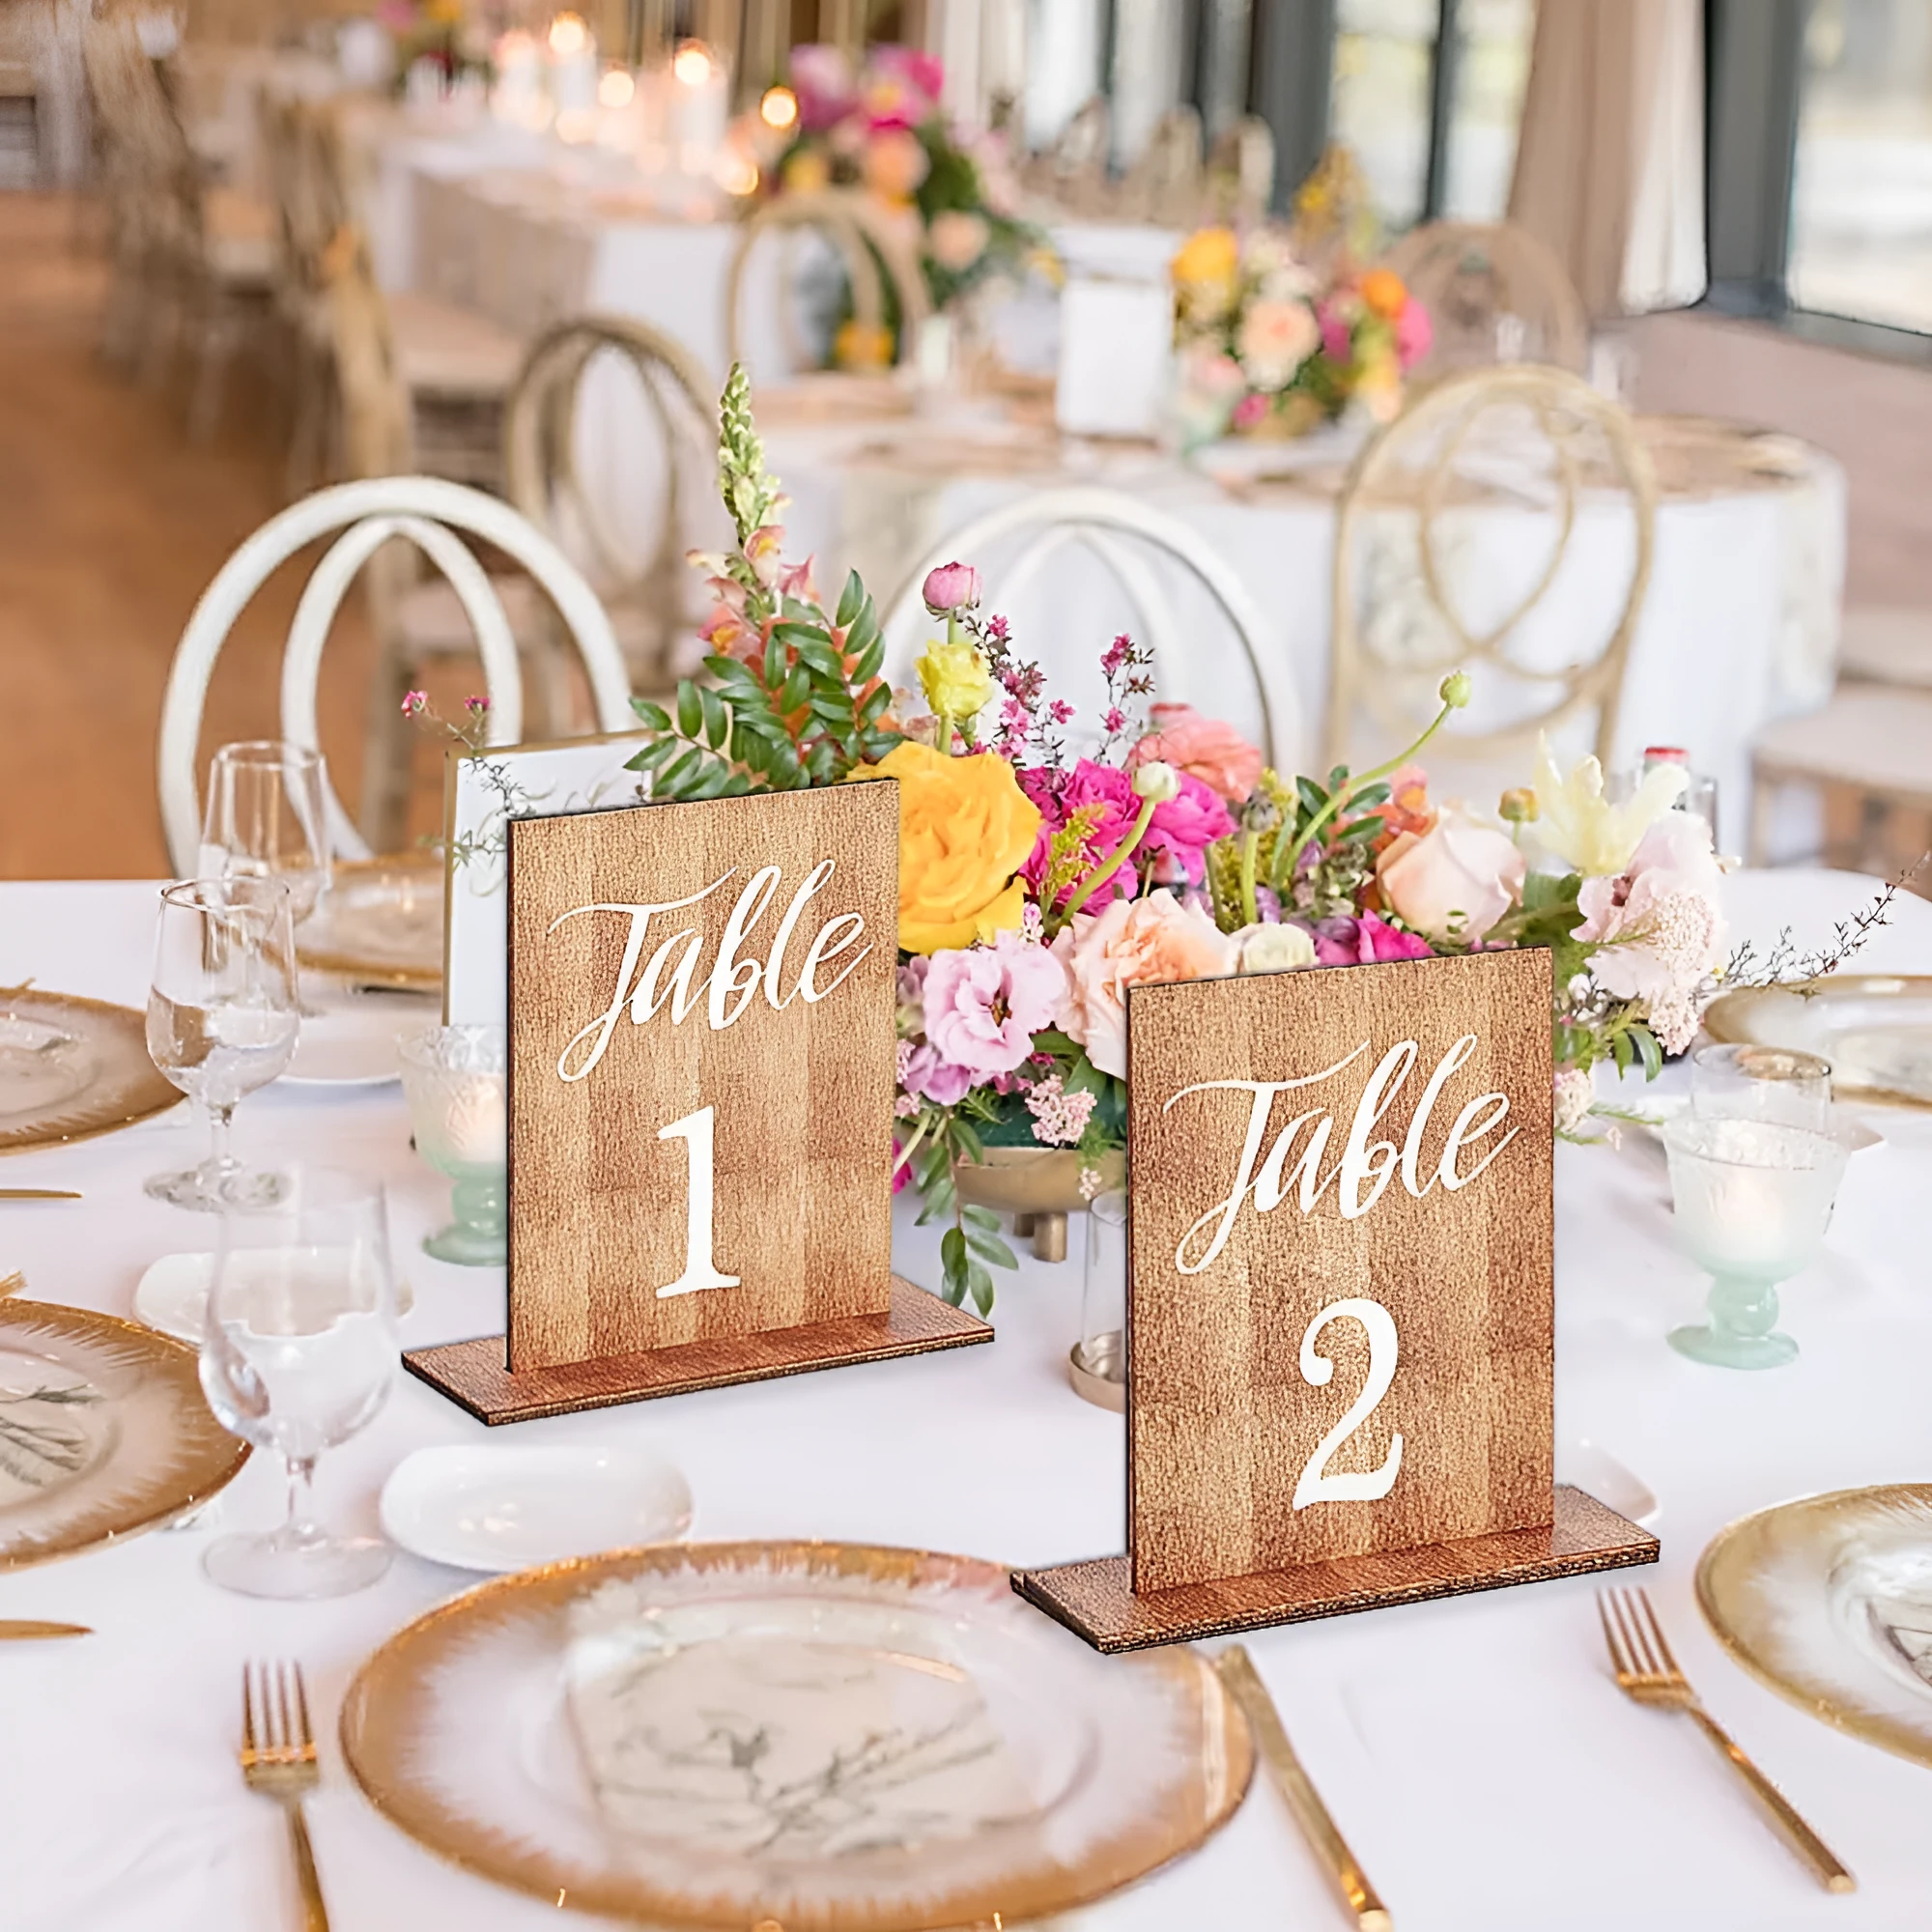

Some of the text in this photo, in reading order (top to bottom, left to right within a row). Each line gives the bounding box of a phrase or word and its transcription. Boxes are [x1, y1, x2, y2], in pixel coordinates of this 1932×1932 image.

[547, 859, 873, 1082] Table
[655, 1105, 741, 1299] 1
[1163, 1033, 1520, 1275] Table
[1293, 1296, 1404, 1510] 2
